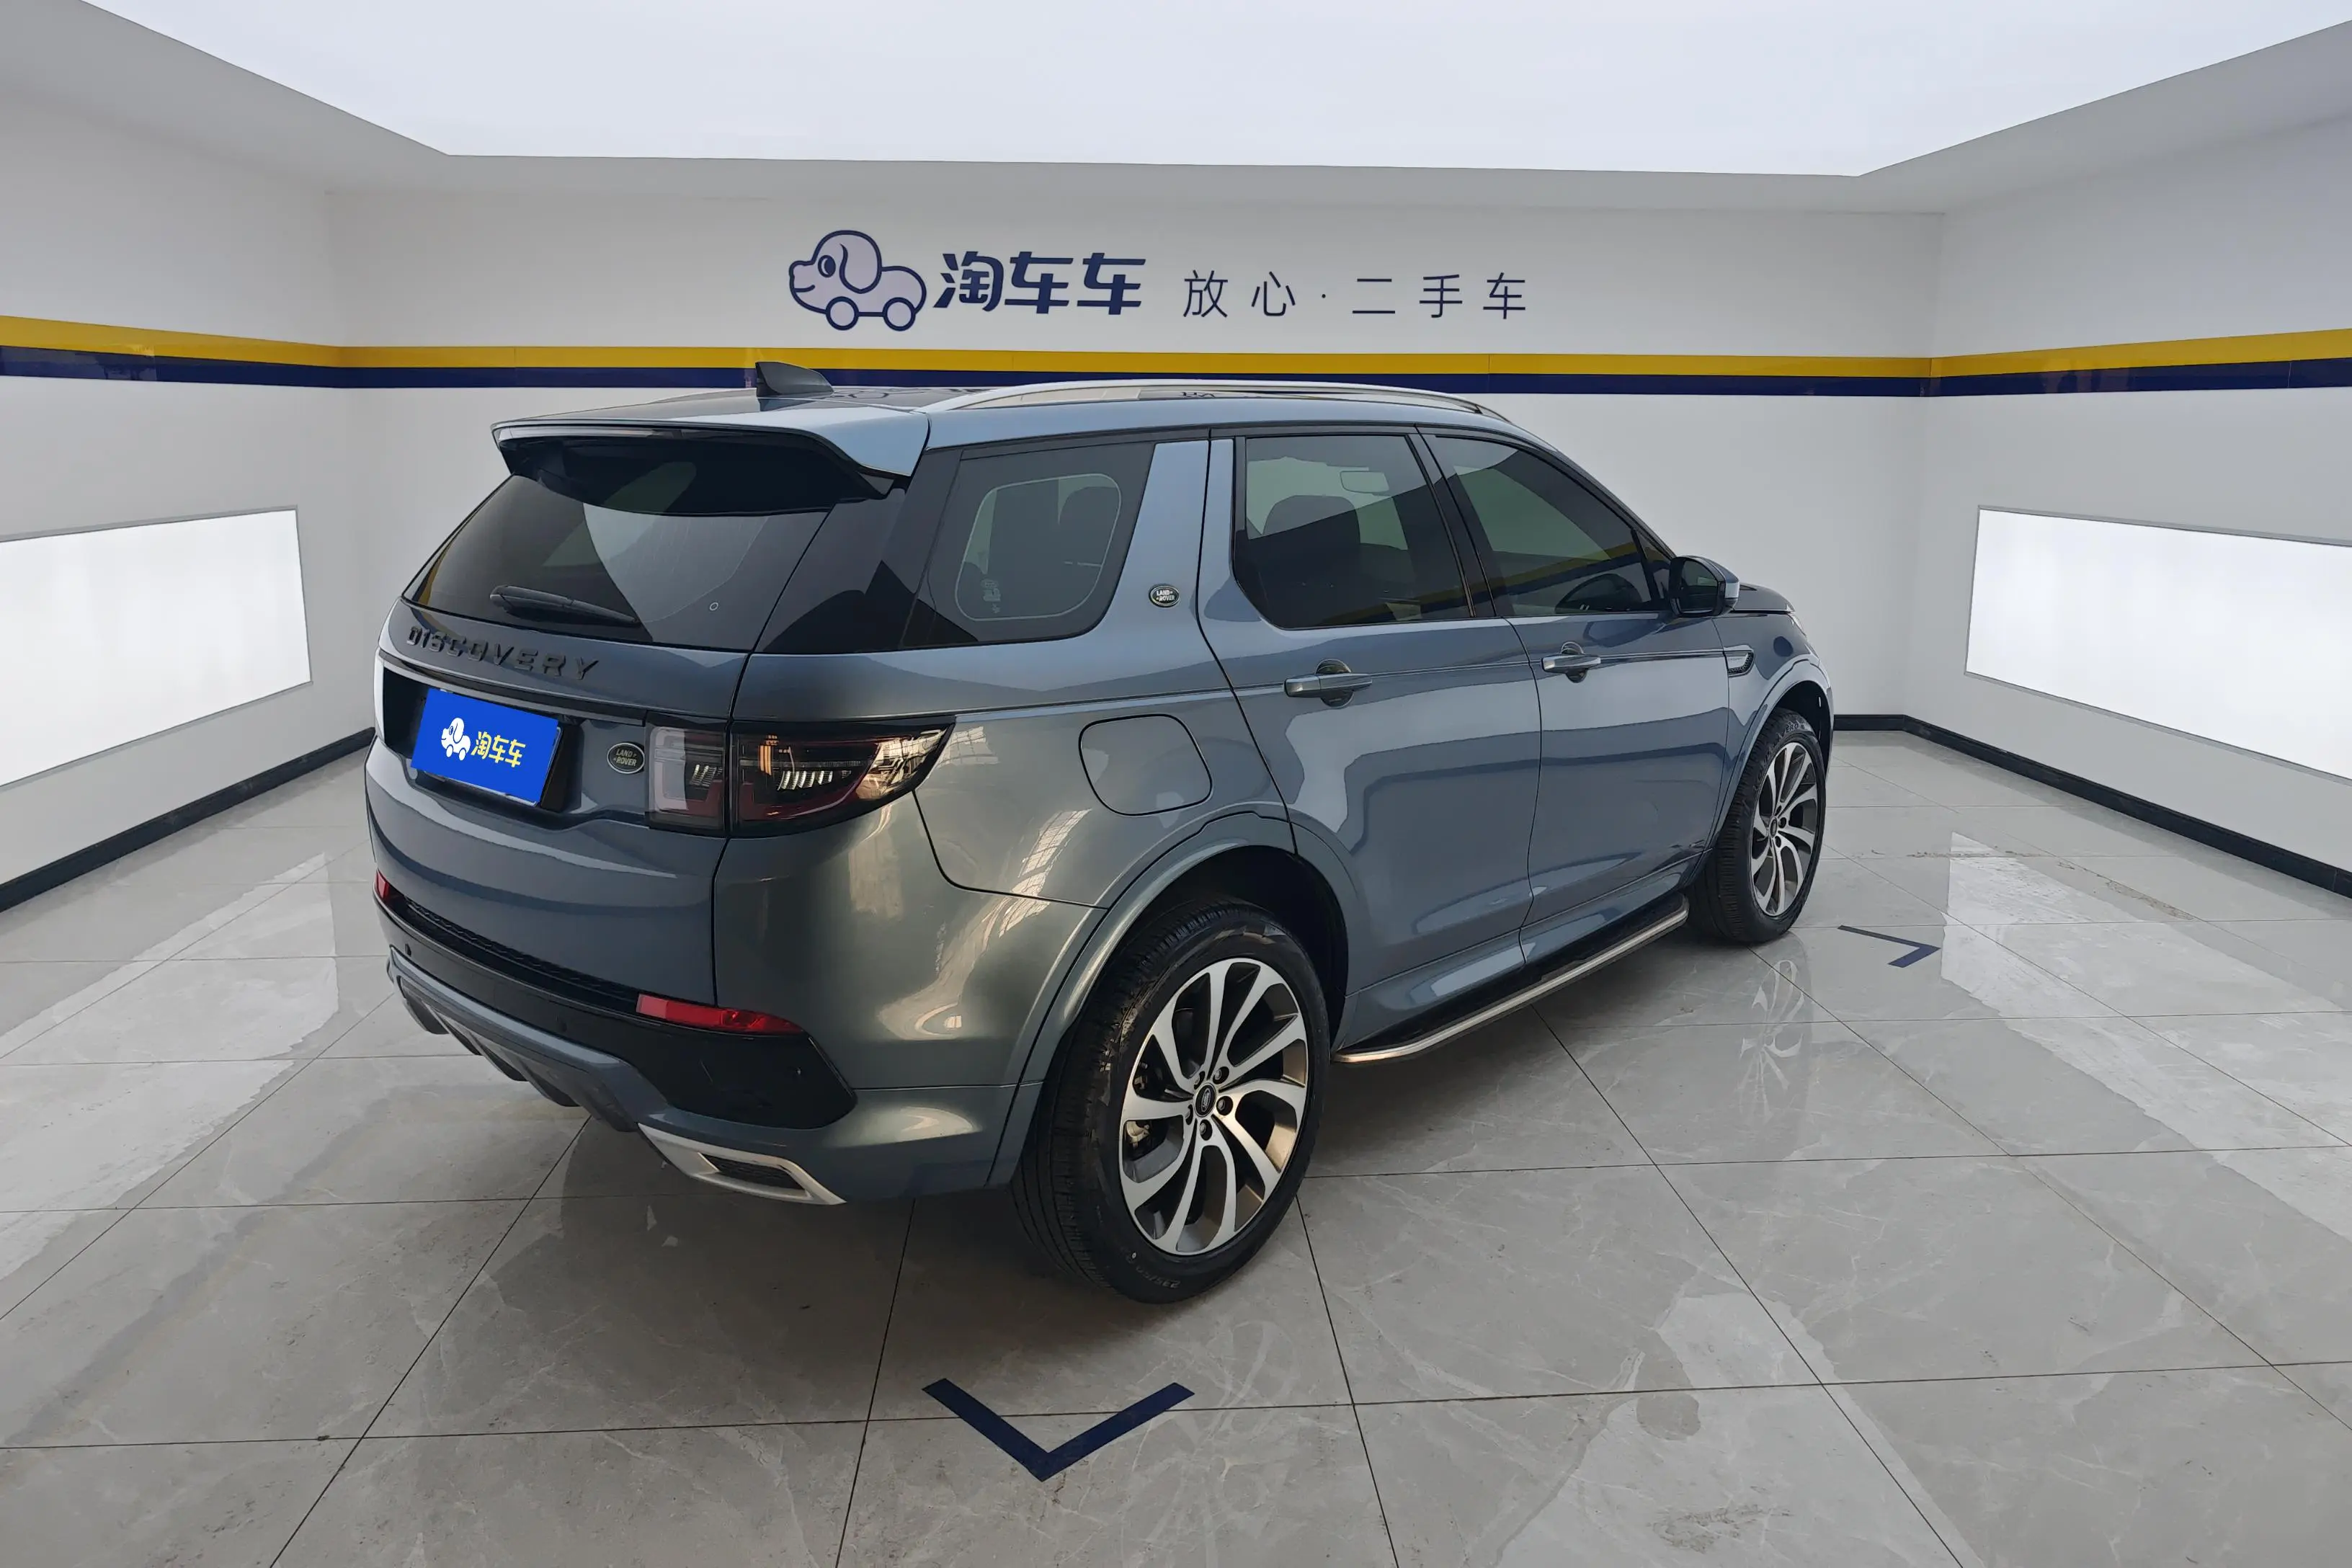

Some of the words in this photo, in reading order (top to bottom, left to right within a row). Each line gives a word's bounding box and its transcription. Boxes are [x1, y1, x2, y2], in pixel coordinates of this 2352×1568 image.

[932, 250, 1146, 315] 淘车车
[406, 625, 600, 680] DISCOVERY
[615, 749, 633, 757] LAND
[615, 757, 637, 767] ROVER
